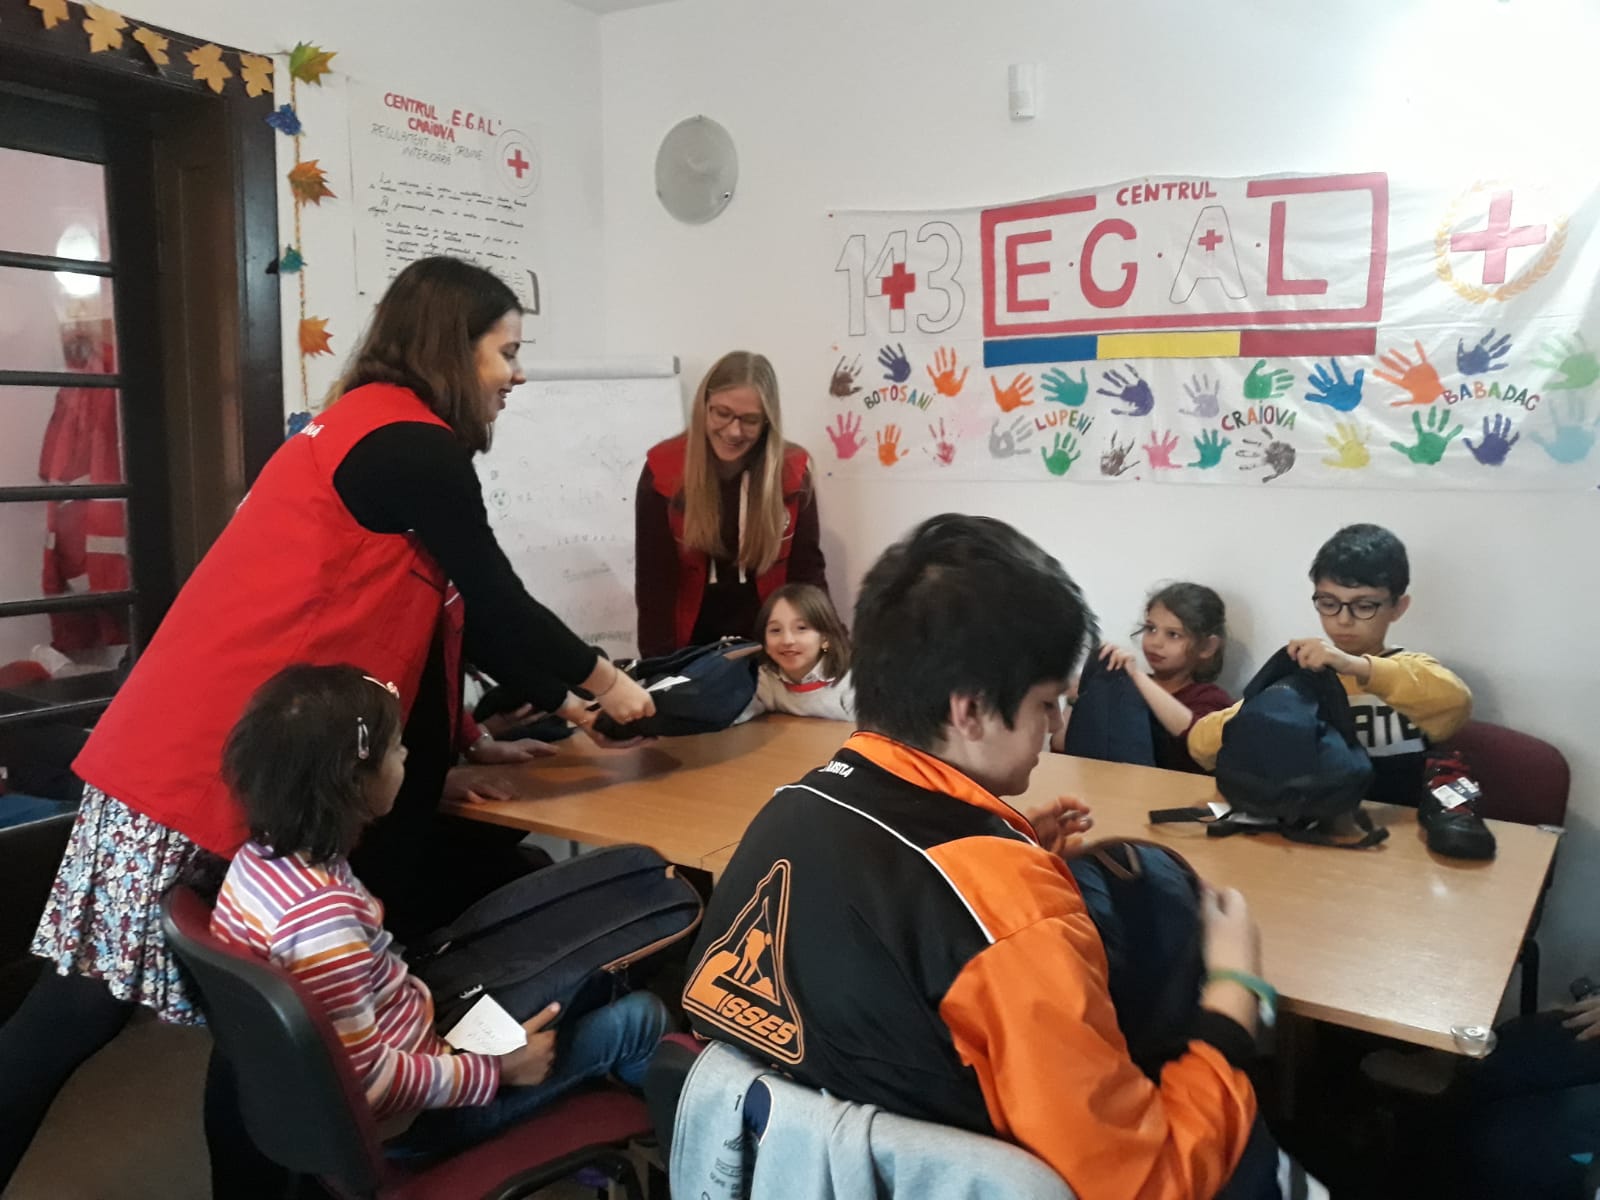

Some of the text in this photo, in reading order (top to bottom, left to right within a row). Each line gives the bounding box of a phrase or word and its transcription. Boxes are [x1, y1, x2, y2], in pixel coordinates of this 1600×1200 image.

[384, 92, 438, 120] CENTRUL
[1116, 181, 1217, 207] CENTRUL
[1442, 380, 1541, 412] BABADAC
